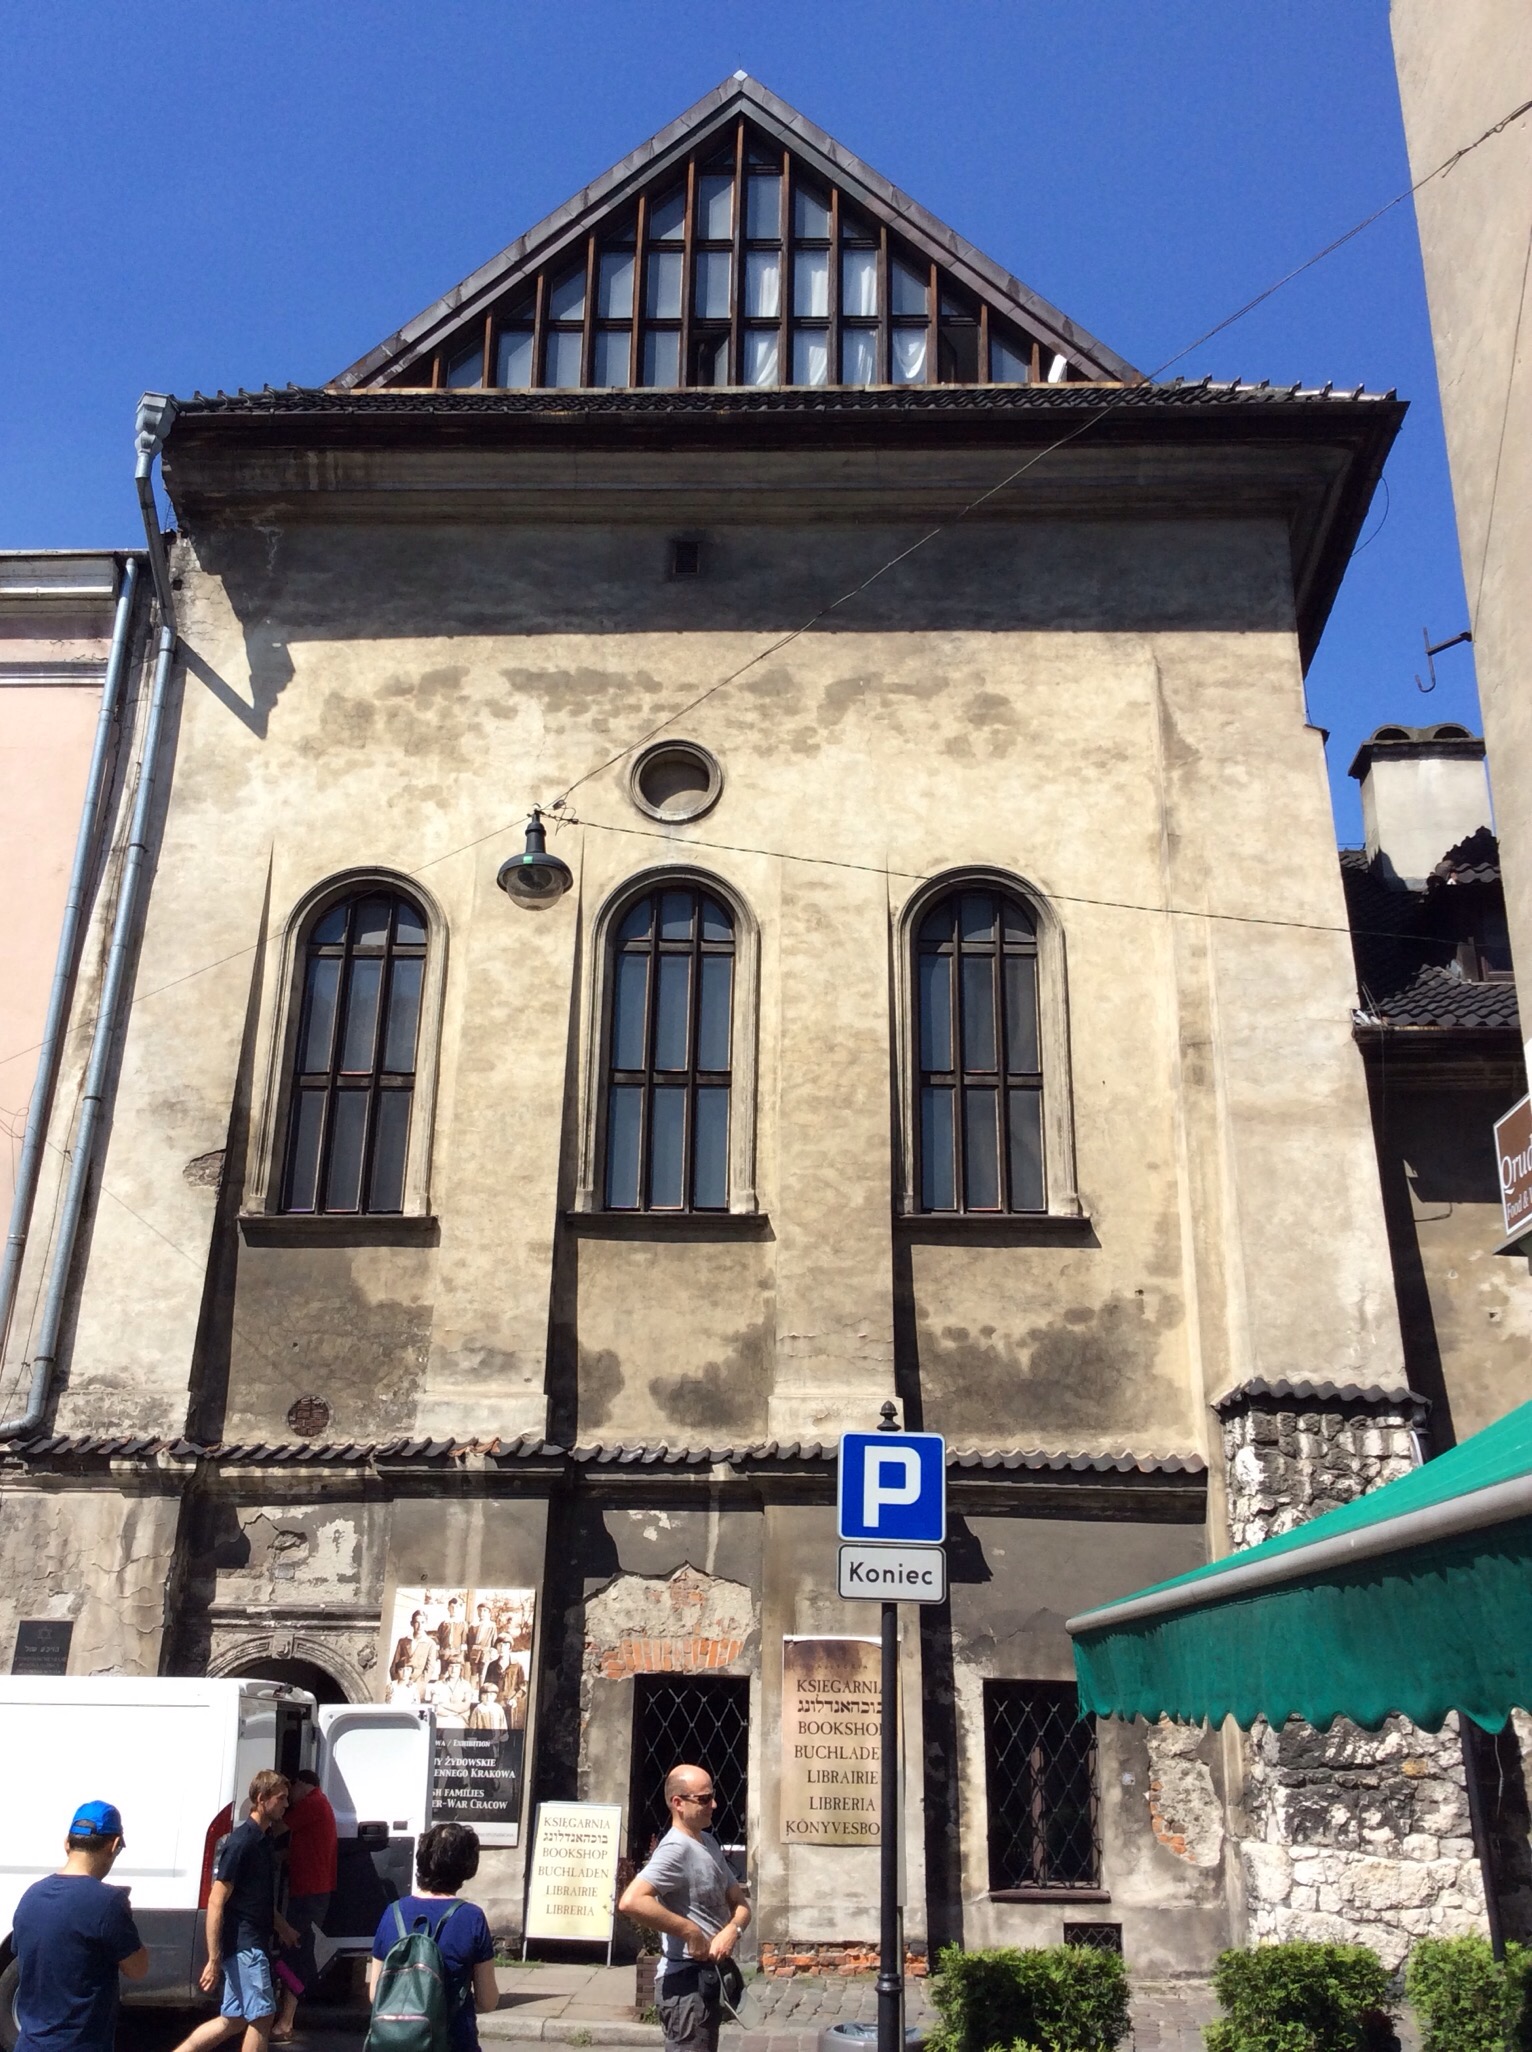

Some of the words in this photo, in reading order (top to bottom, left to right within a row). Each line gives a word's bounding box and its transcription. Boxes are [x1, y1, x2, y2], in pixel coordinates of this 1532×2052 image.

[862, 1445, 922, 1528] P
[849, 1561, 933, 1586] Koniec
[796, 1679, 882, 1694] KSIEGARNI
[798, 1721, 882, 1736] BOOKSHO
[794, 1744, 880, 1760] BUCHLADE
[444, 1755, 497, 1767] ŻYDOWSKIE
[433, 1768, 469, 1778] ENNEGO
[807, 1769, 879, 1785] LIBRAIRIE
[444, 1788, 485, 1798] FAMILIES
[432, 1798, 468, 1809] ER-WAR
[809, 1796, 876, 1812] LIBRERIA
[543, 1816, 611, 1830] KSIĘGARNIA
[785, 1818, 881, 1836] KÖNYVESBO
[542, 1847, 608, 1860] BOOKSHOP
[538, 1865, 610, 1879] BUCHLADEN
[545, 1884, 598, 1897] LIBRAIRIE
[545, 1903, 595, 1917] LIBRERIA
